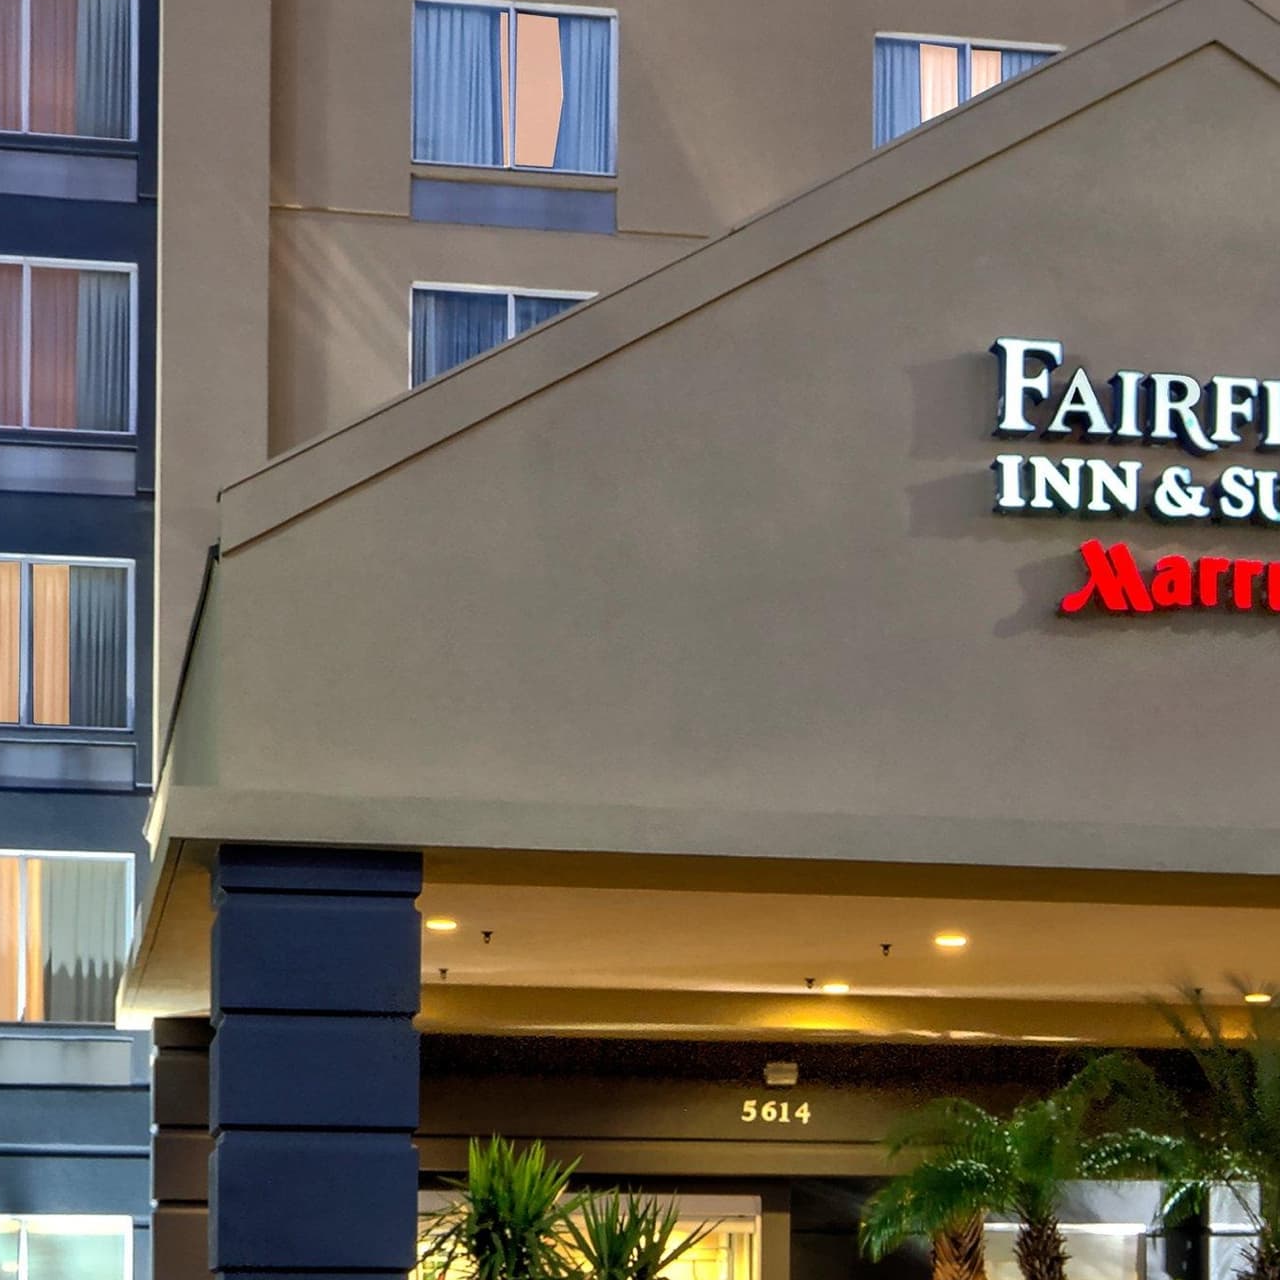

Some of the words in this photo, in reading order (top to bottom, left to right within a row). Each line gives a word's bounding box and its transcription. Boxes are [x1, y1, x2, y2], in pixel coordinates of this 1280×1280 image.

[993, 454, 1143, 515] INN
[1152, 465, 1210, 517] &
[741, 1099, 812, 1125] 5614
